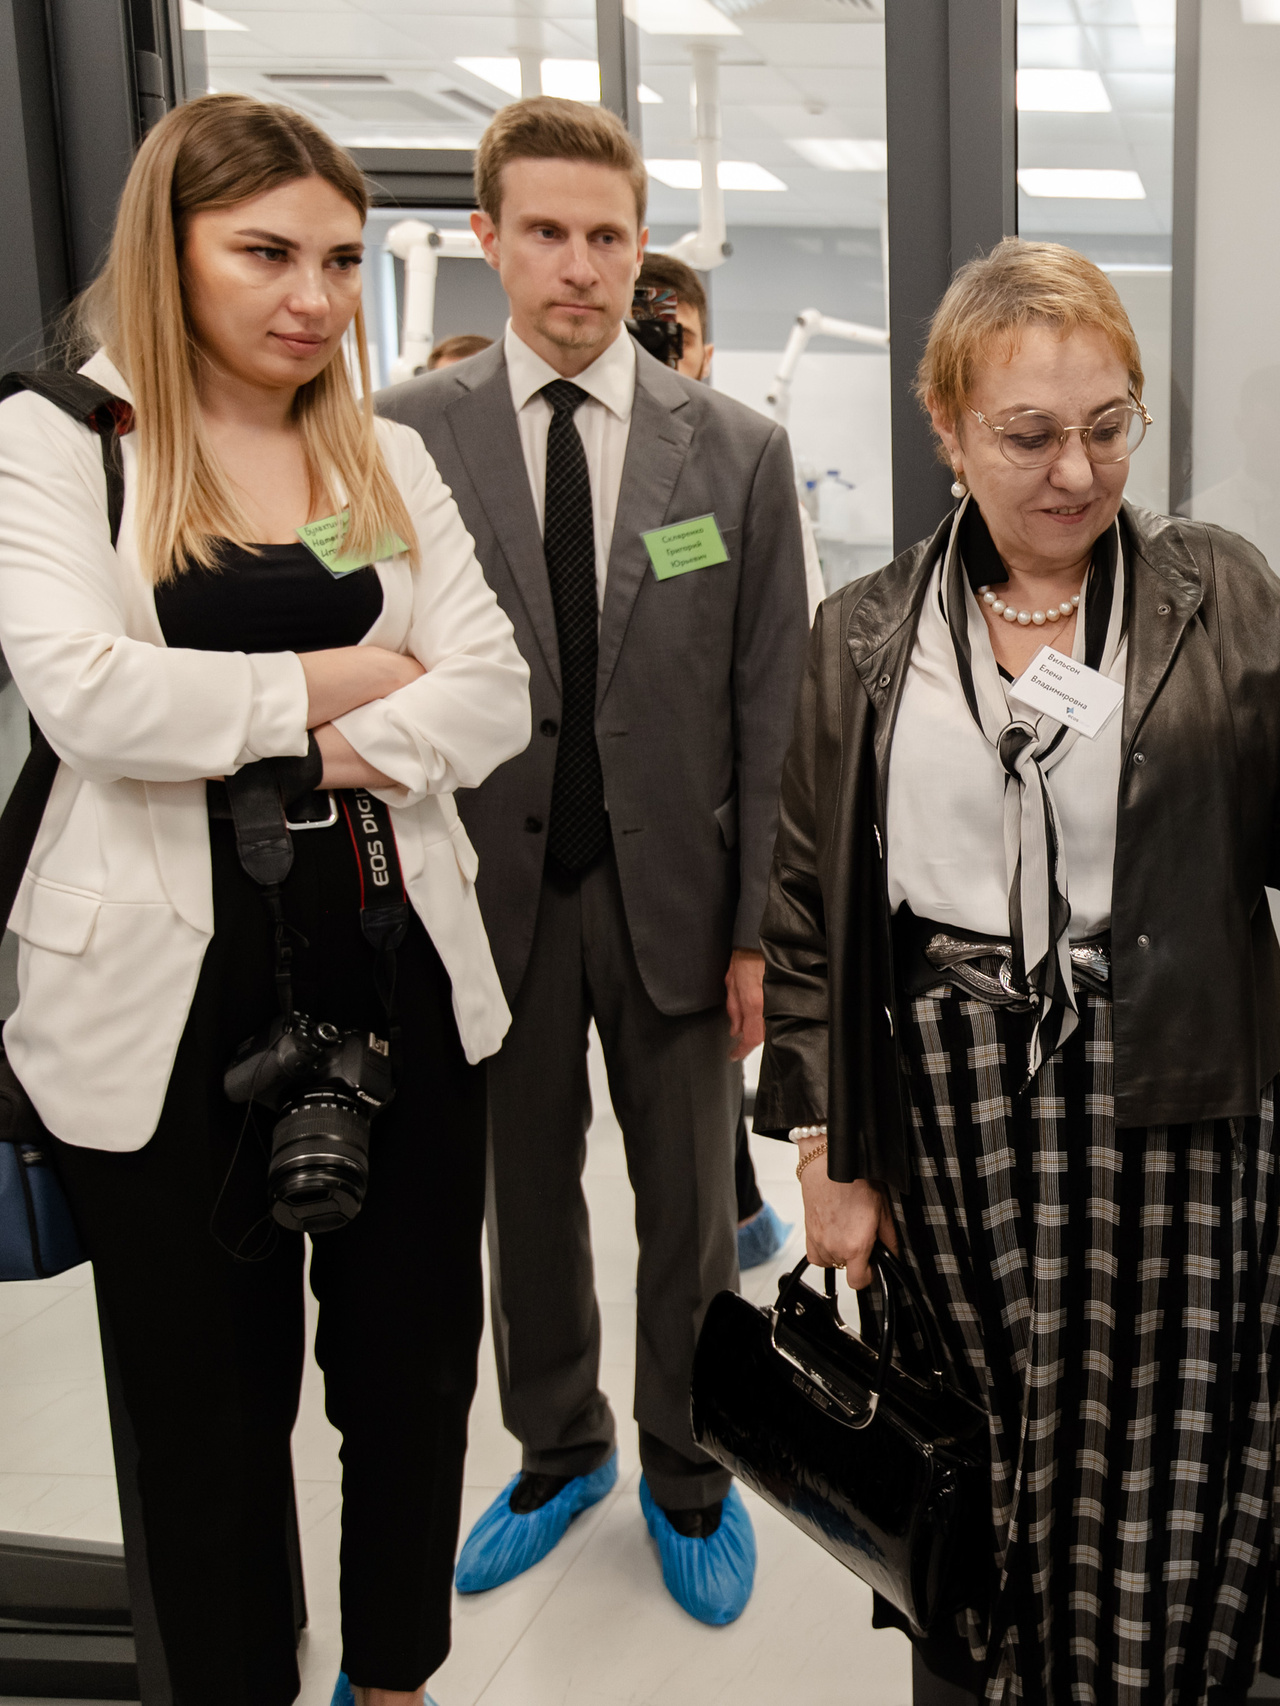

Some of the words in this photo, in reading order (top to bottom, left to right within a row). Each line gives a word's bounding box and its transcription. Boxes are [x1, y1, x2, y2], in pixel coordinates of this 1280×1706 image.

[666, 540, 702, 557] Григорий
[1038, 663, 1063, 682] Елена
[1047, 652, 1081, 676] Вильсон
[1030, 674, 1089, 711] Владимировна
[366, 839, 391, 887] EOS
[356, 1090, 382, 1107] Canon
